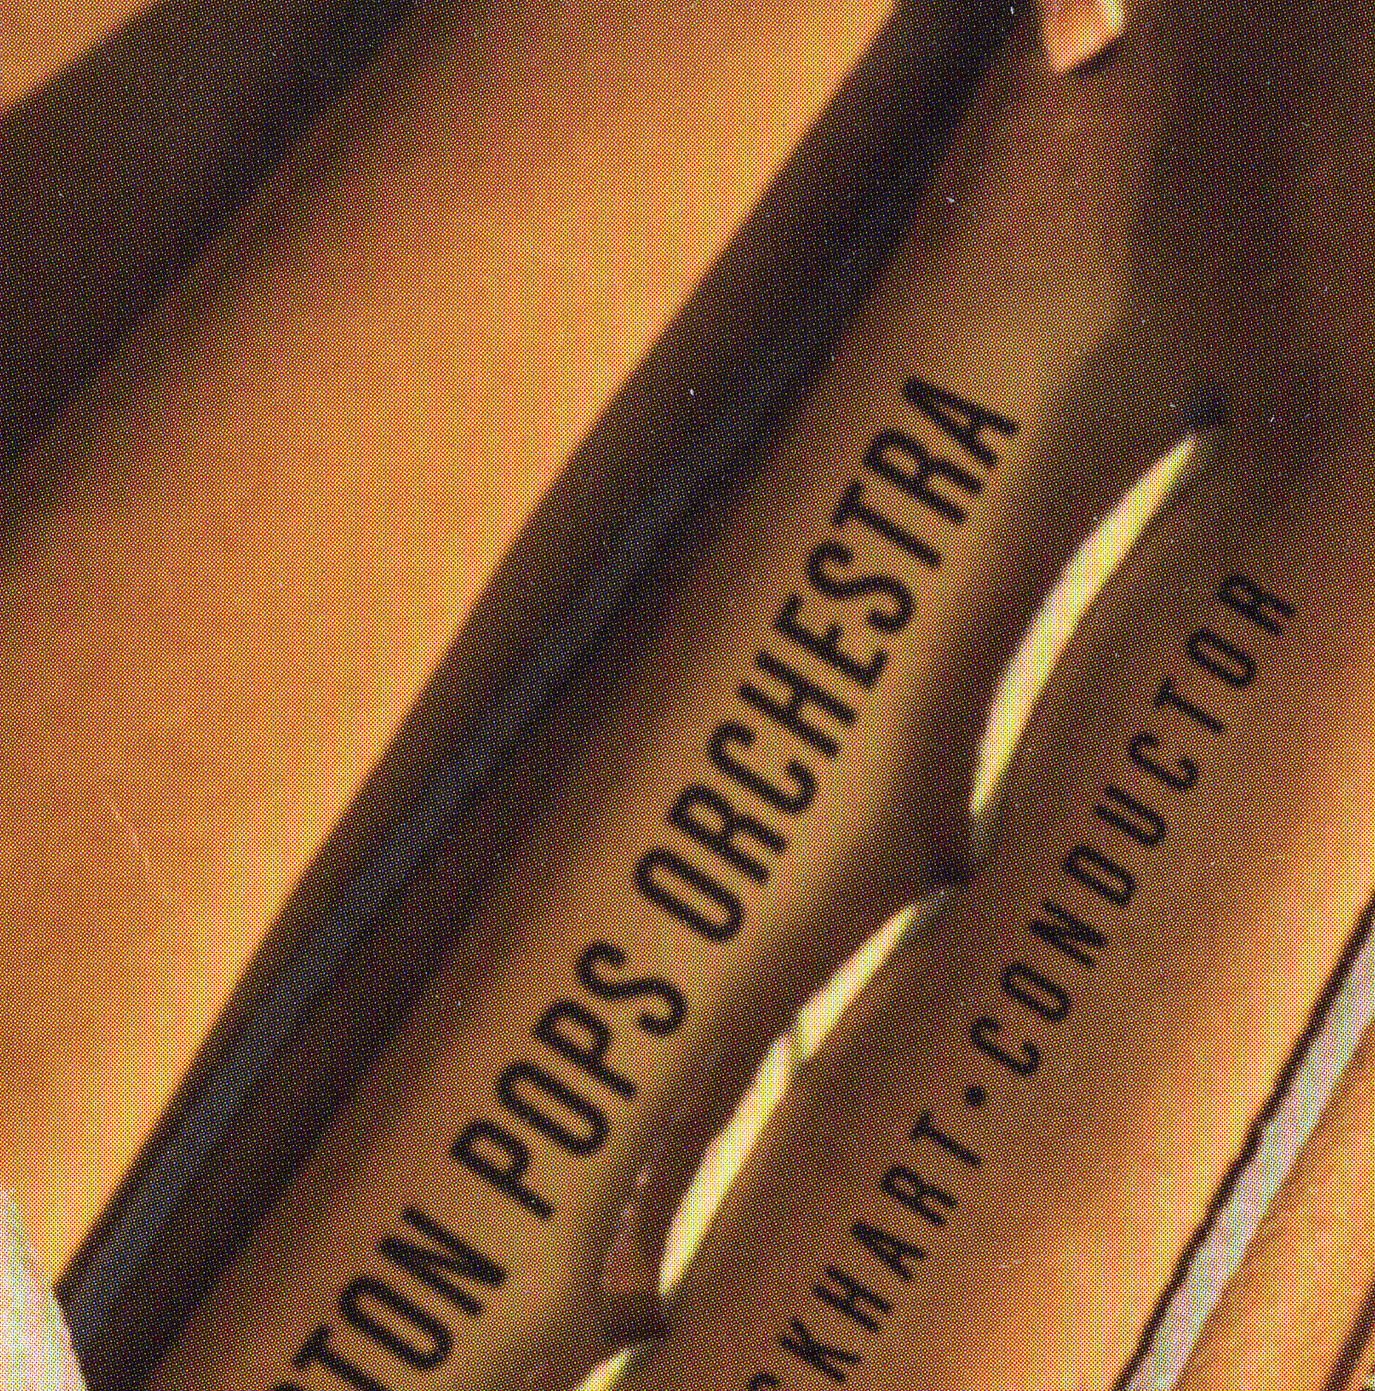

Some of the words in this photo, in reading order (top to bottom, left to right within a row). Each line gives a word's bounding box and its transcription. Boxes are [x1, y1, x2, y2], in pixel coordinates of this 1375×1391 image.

[451, 941, 688, 1216] POPS
[633, 377, 1020, 942] ORCHESTRA
[968, 574, 1297, 1077] CONDUCTOR
